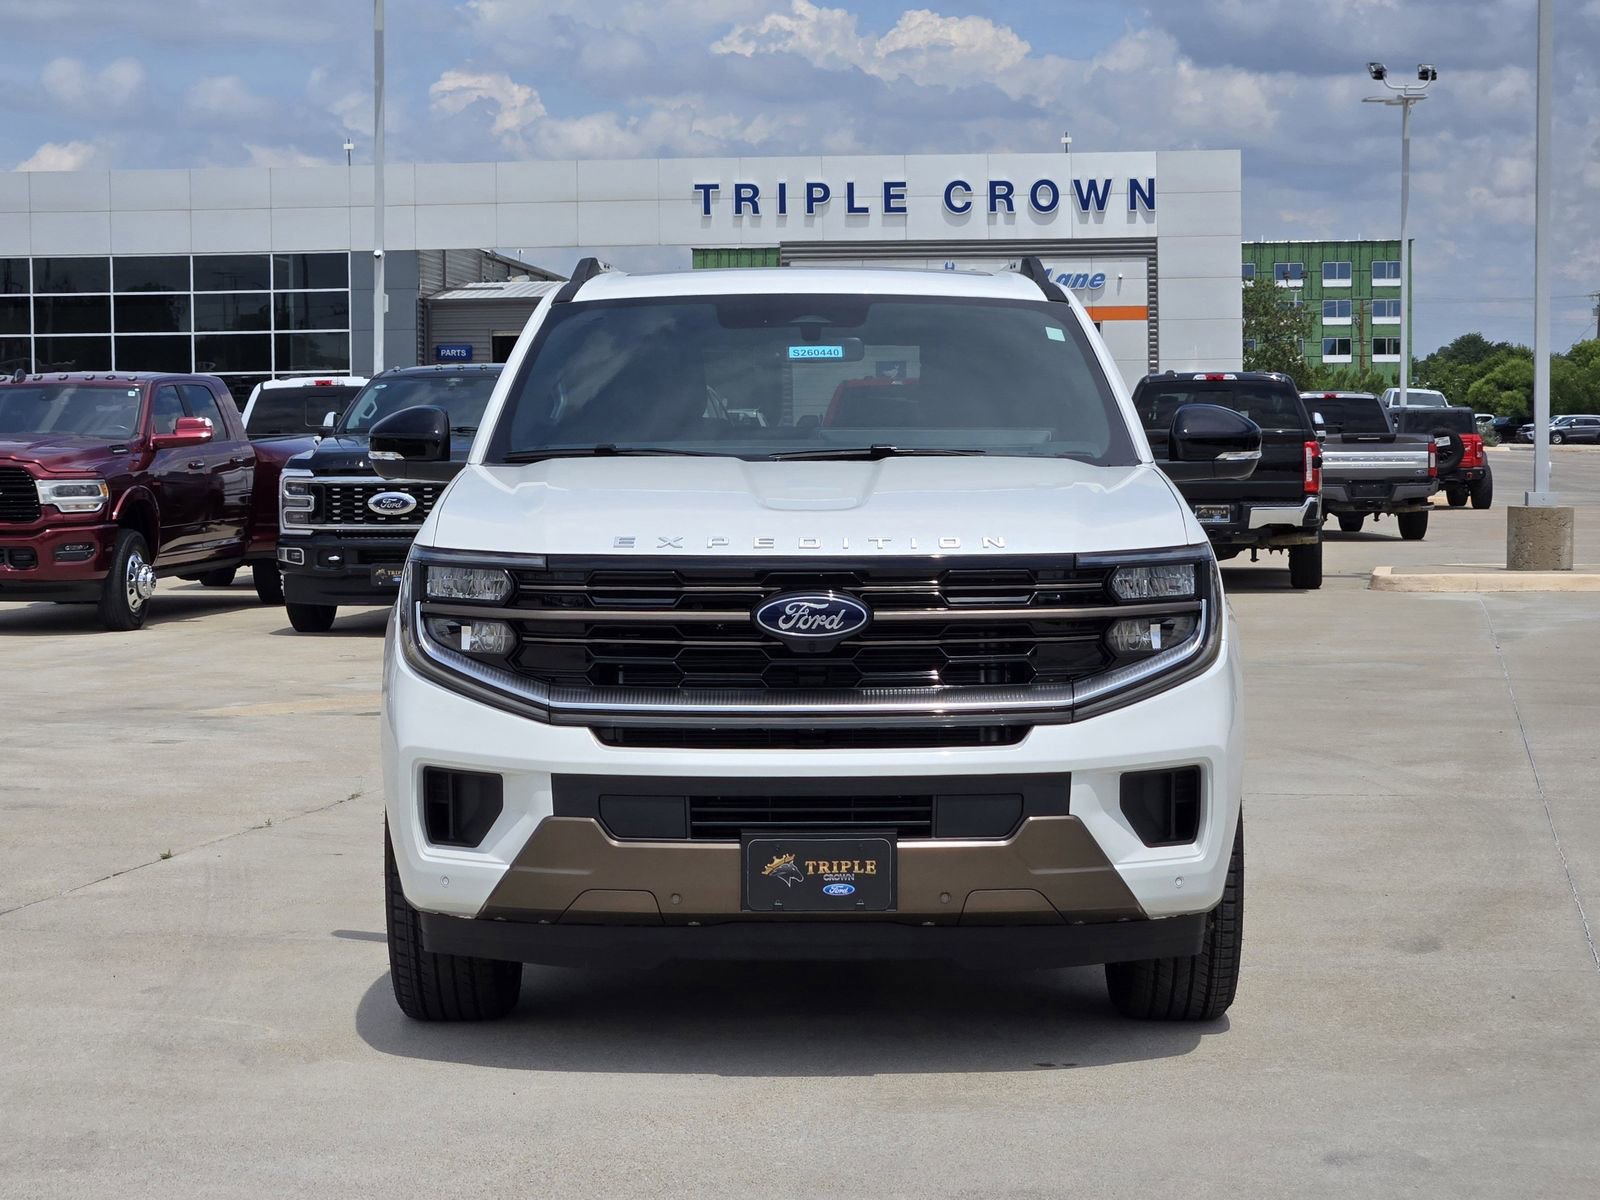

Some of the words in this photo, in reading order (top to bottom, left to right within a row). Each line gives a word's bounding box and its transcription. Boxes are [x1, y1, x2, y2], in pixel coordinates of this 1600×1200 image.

[693, 181, 908, 216] TRIPLE
[943, 177, 1156, 214] CROWN
[1044, 268, 1106, 290] ane
[440, 349, 467, 357] PARTS
[792, 348, 840, 357] S260440
[380, 498, 403, 508] Ford
[613, 535, 1006, 549] EXPEDITION
[777, 601, 846, 631] Ford
[804, 859, 877, 875] TRIPLE
[823, 873, 855, 881] CROWN
[828, 884, 851, 895] Ford
